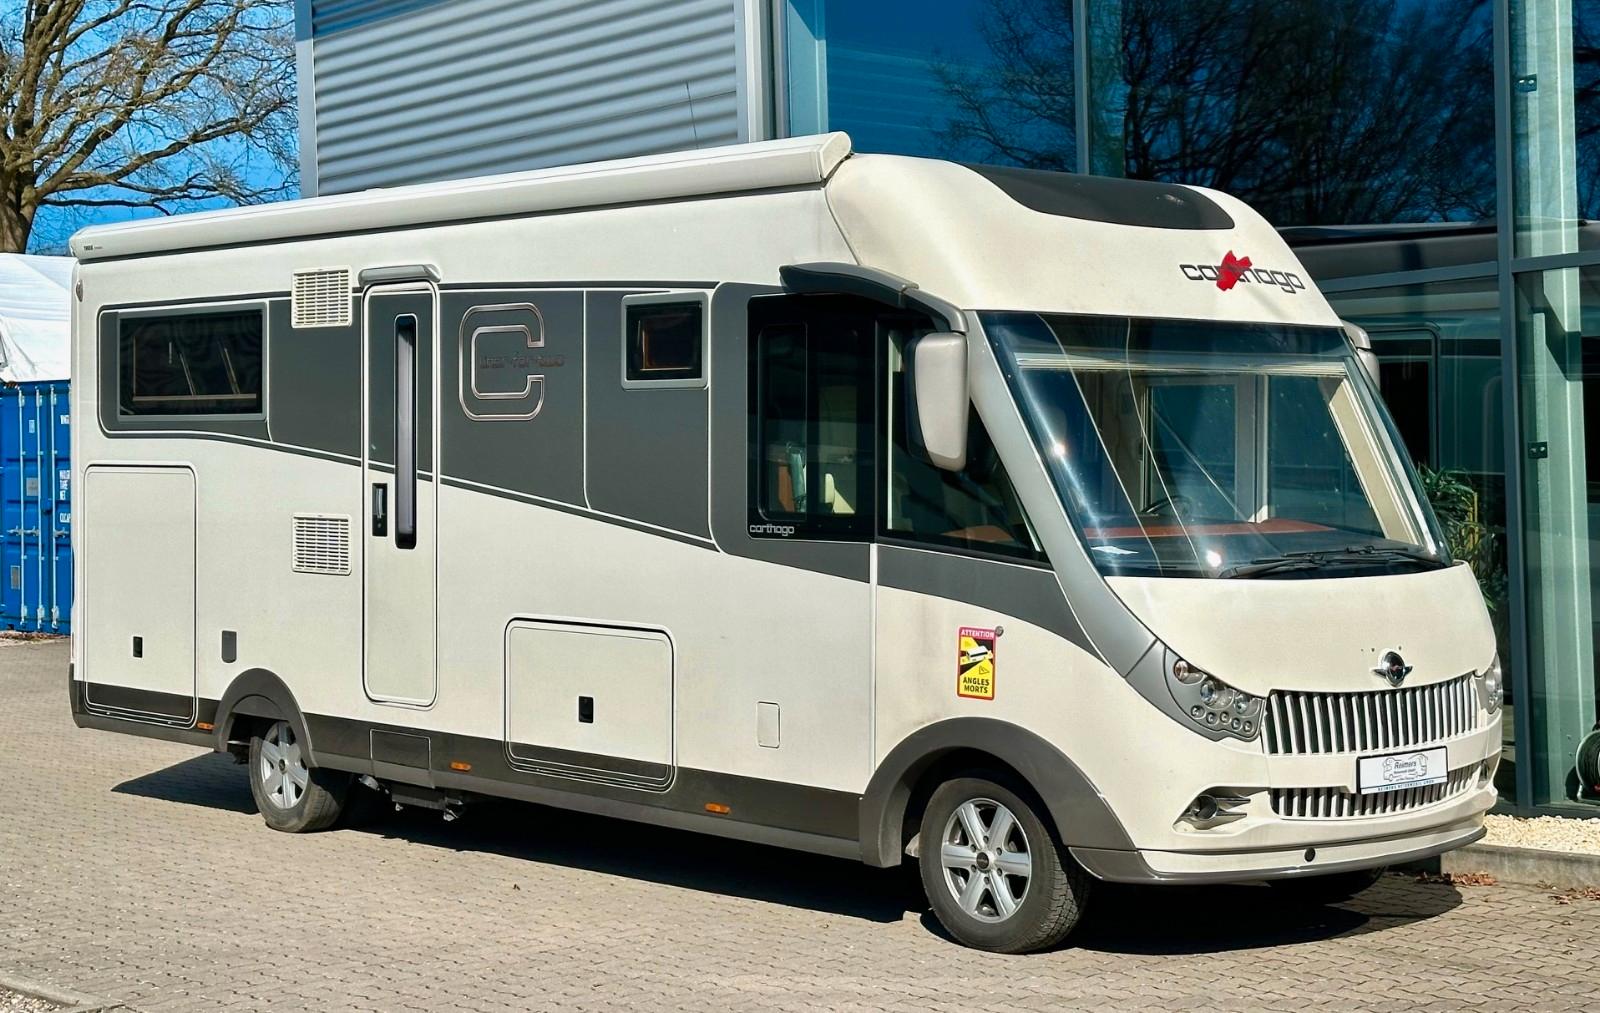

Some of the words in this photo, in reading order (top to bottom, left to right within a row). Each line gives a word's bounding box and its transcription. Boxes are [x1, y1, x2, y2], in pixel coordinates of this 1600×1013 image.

[1179, 264, 1306, 294] cahago
[750, 523, 795, 537] carthago
[961, 629, 995, 638] ATTENTION
[963, 676, 990, 687] ANGLES
[964, 684, 988, 694] MORTS
